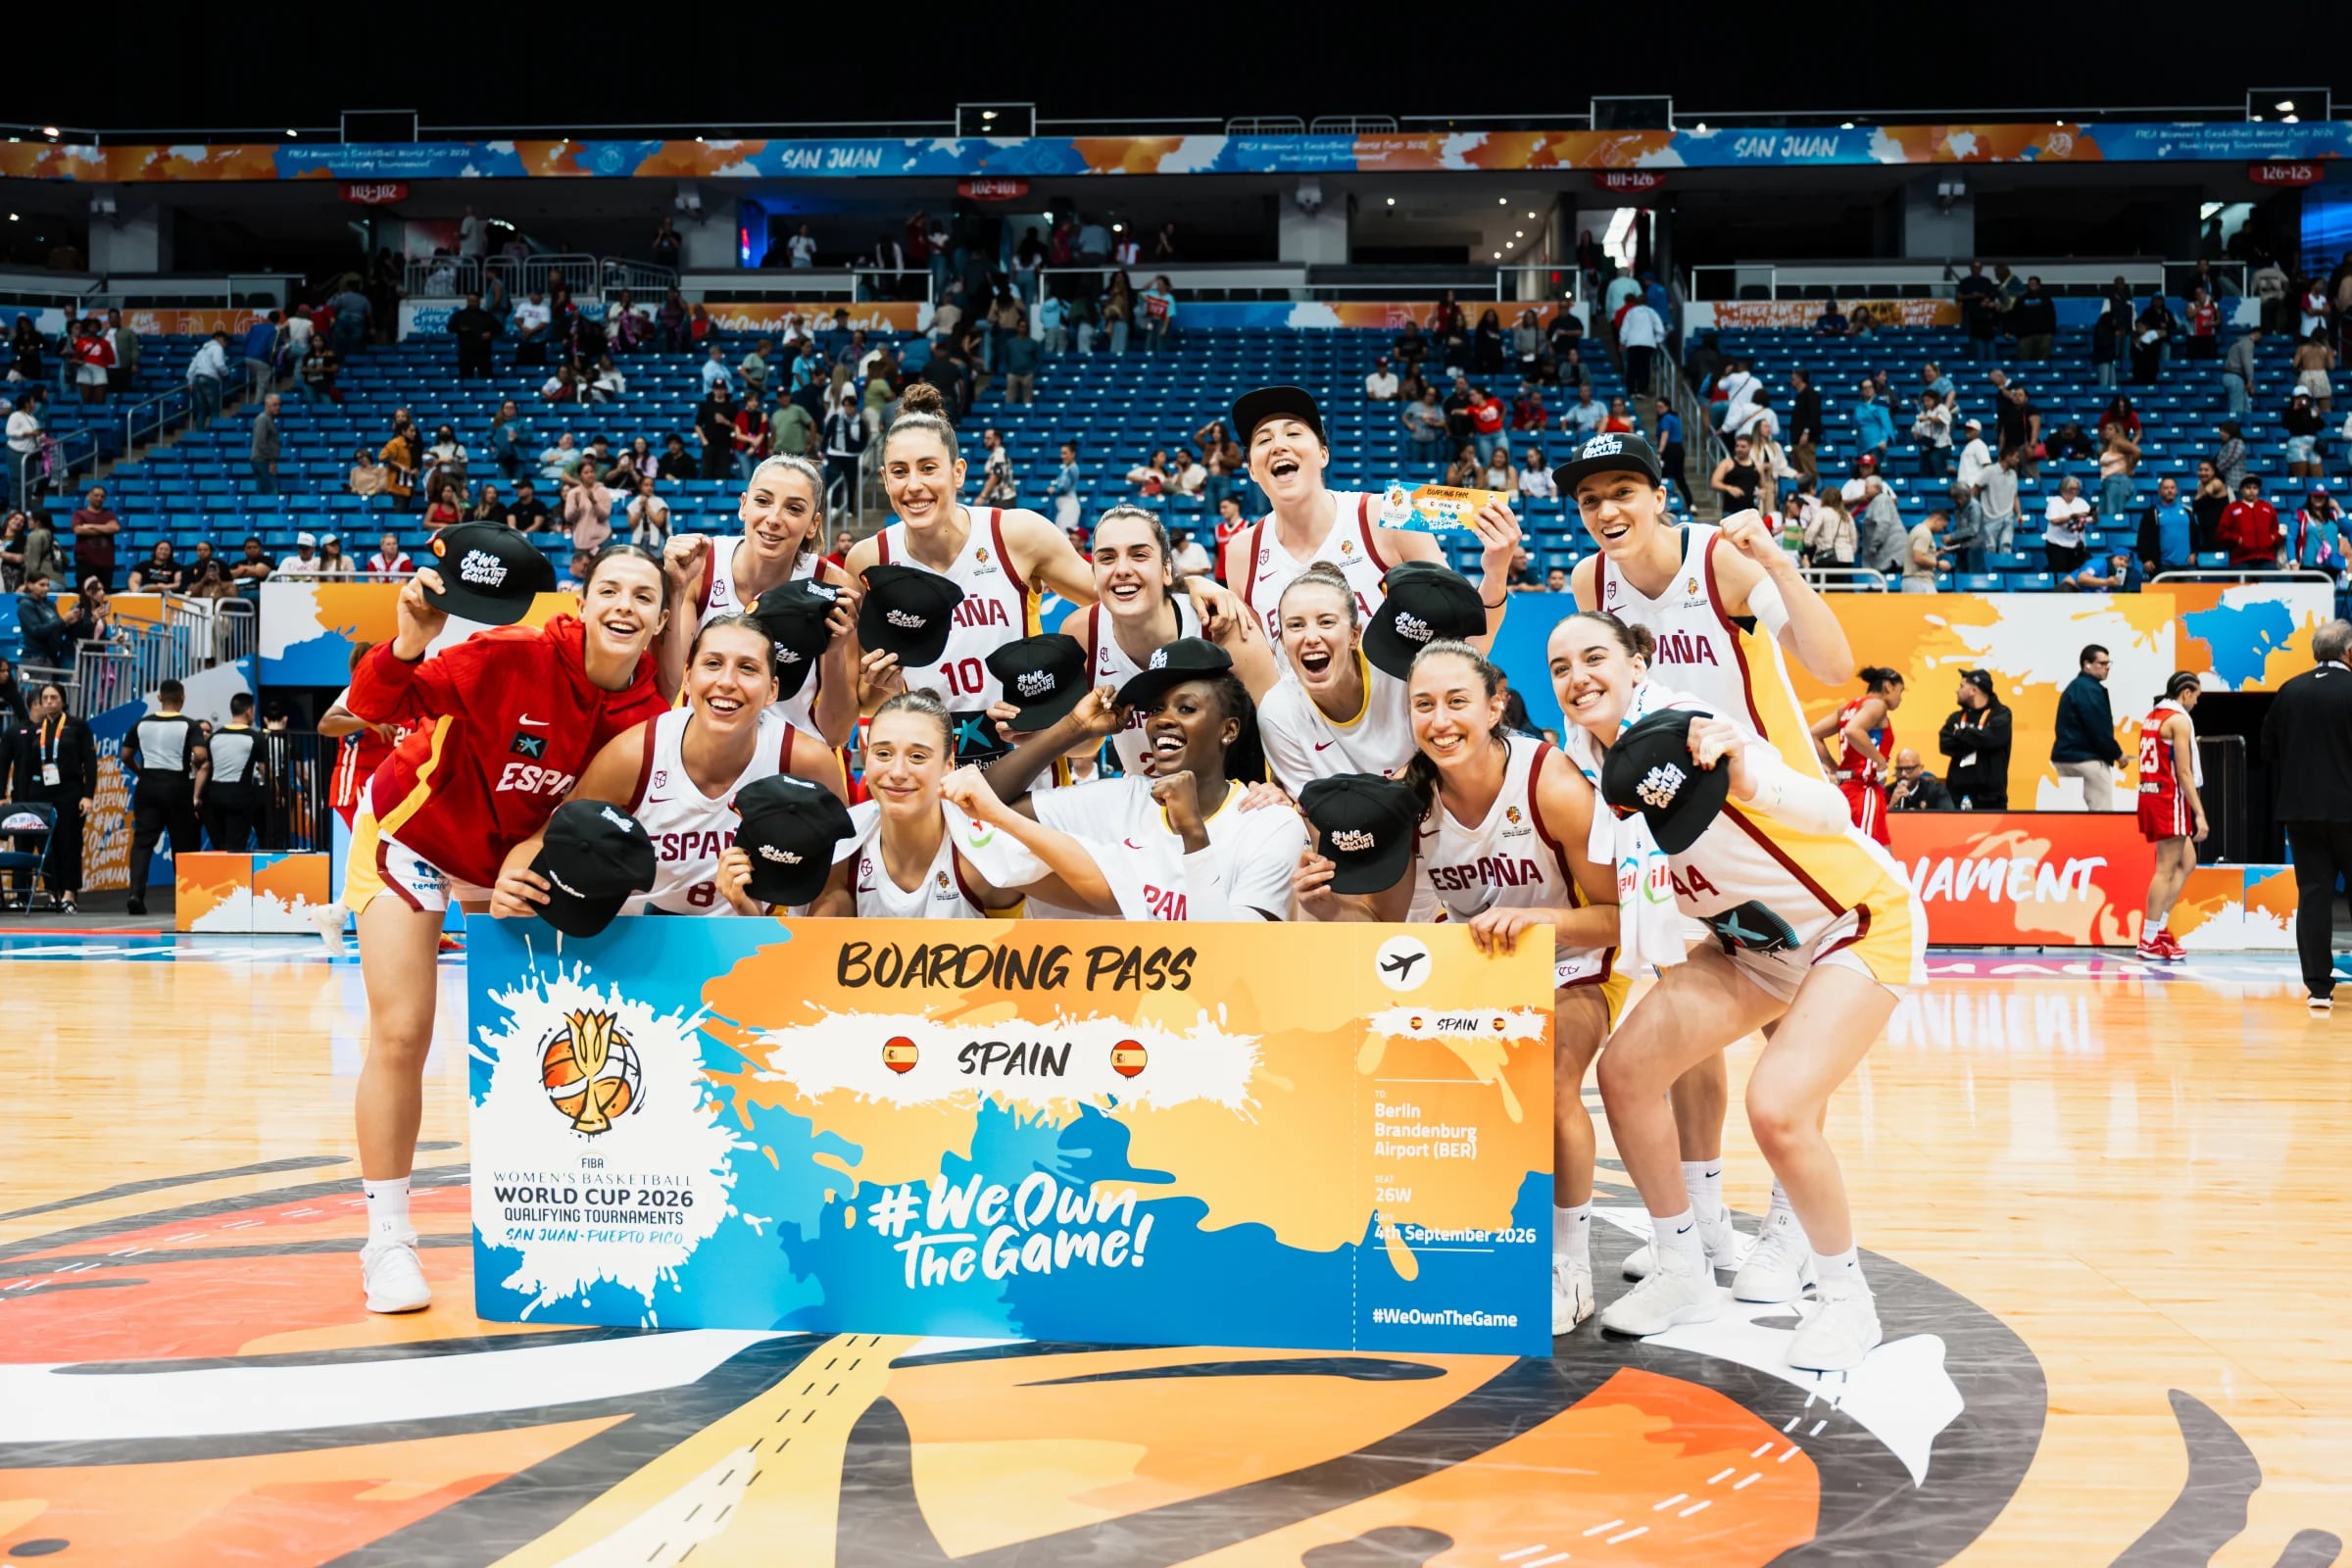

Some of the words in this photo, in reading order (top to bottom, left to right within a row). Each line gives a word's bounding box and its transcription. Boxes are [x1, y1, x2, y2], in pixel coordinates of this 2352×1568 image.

[1734, 137, 1776, 158] SAN
[1781, 136, 1838, 157] JUAN
[782, 149, 821, 169] SAN
[828, 148, 882, 168] JUAN
[1607, 172, 1654, 186] 101-126
[2263, 166, 2312, 180] 126-125
[351, 185, 396, 198] 103-102
[950, 594, 1009, 630] AÑA
[940, 658, 984, 696] 10
[2139, 737, 2159, 773] 23
[1428, 853, 1544, 891] ESPAÑA
[687, 880, 716, 907] 8
[1670, 864, 1721, 903] 44
[837, 941, 1073, 991] BOARDING
[1085, 945, 1198, 992] PASS
[1437, 1018, 1479, 1032] SPAIN
[957, 1041, 1073, 1077] SPAIN
[1374, 1102, 1421, 1118] Berlin
[1374, 1122, 1477, 1142] Brandenburg
[1374, 1142, 1430, 1160] Airport
[1433, 1143, 1478, 1160] (BER)
[581, 1157, 604, 1169] FIBA
[494, 1171, 576, 1184] WOMEN'S
[582, 1173, 694, 1187] BASKETBALL
[1375, 1175, 1395, 1184] SEAT
[494, 1187, 578, 1204] WORLD
[585, 1188, 631, 1205] CUP
[637, 1190, 694, 1207] 2026
[1375, 1188, 1412, 1203] 26W
[505, 1207, 580, 1222] QUALIFYING
[585, 1209, 683, 1225] TOURNAMENTS
[1374, 1213, 1395, 1222] DATE
[506, 1228, 534, 1241] SAN
[539, 1228, 578, 1243] JUAN
[588, 1229, 644, 1245] PUERTO
[649, 1231, 683, 1246] RICO
[1374, 1225, 1401, 1240] 4th
[1405, 1226, 1491, 1245] September
[1494, 1228, 1537, 1244] 2026
[1372, 1307, 1518, 1327] #WeOwnTheGame
